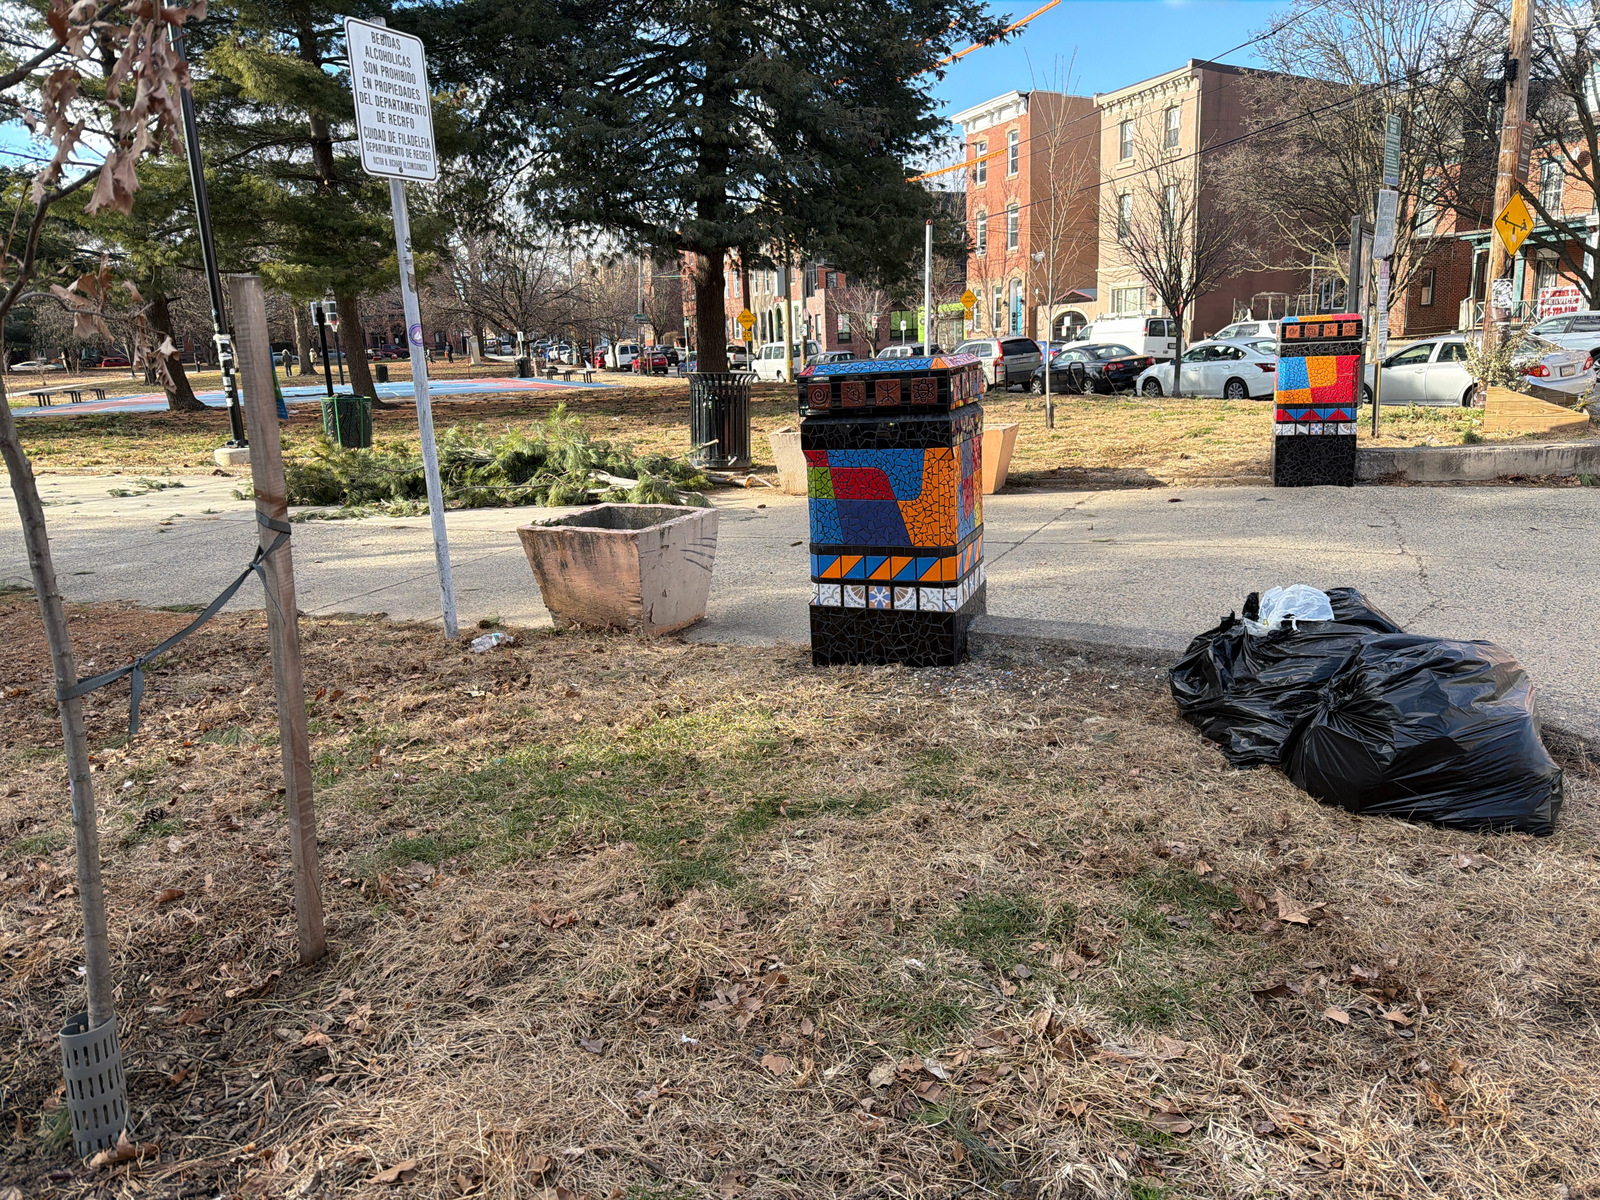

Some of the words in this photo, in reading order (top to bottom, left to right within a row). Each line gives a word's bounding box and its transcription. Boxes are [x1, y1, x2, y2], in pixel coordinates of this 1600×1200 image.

[371, 31, 401, 51] BEBIDAS
[365, 45, 412, 69] ALCOHOLICAS
[363, 60, 379, 76] SON
[380, 65, 417, 85] PROHIBIDO
[362, 76, 372, 90] EN
[374, 79, 420, 101] PROPIEDADES
[359, 91, 373, 106] DEL
[375, 95, 427, 117] DEPARTAMENTO
[376, 110, 386, 124] DE
[363, 126, 387, 142] CUIDAD
[388, 130, 397, 144] DE
[398, 132, 431, 150] FILADELFIA
[366, 141, 404, 158] DEPARTAMENTO
[405, 148, 413, 159] DE
[413, 149, 432, 162] RECREO
